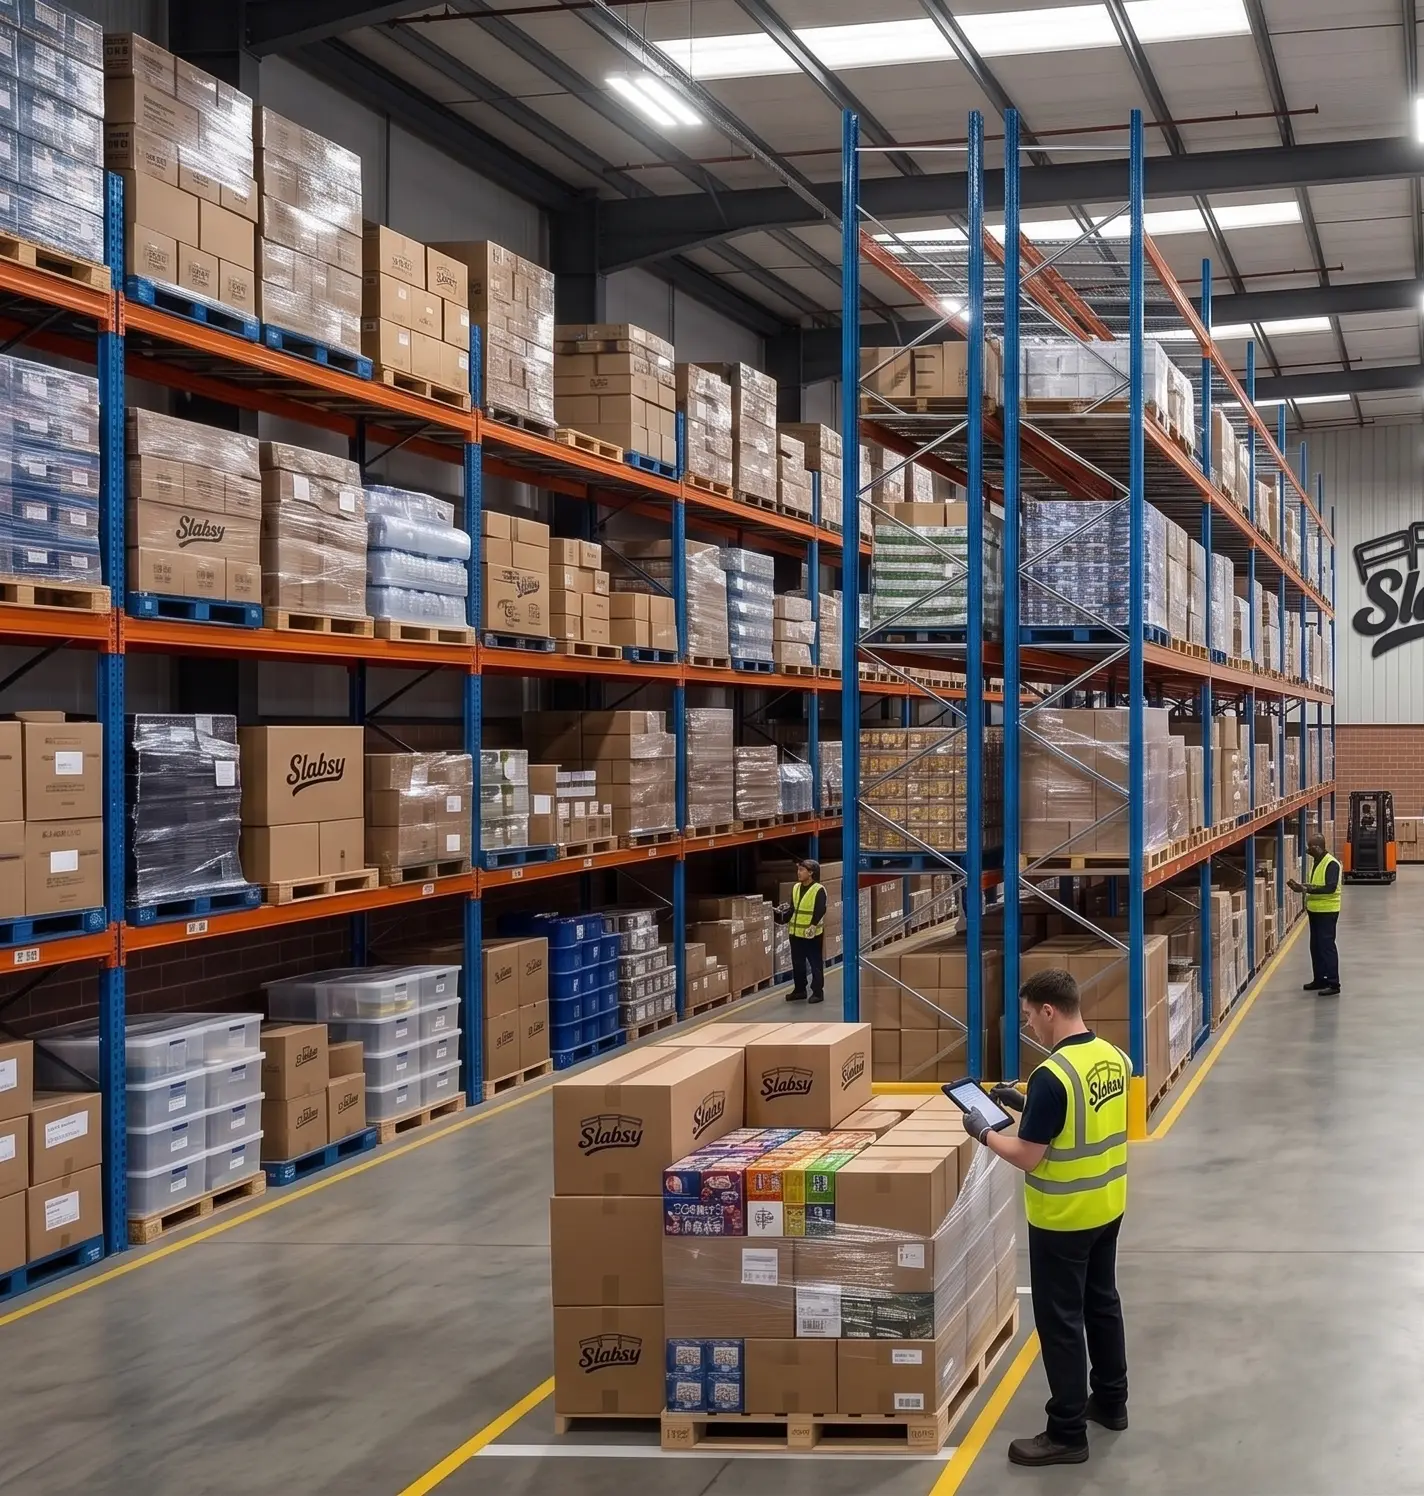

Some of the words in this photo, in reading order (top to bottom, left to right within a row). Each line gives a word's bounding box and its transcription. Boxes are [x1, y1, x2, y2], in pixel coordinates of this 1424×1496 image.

[175, 515, 225, 548] Slabsy
[286, 752, 346, 797] Slabsy
[760, 1075, 813, 1102] Slabsy
[578, 1127, 643, 1156] Slabsy
[578, 1346, 641, 1374] Slabsy
